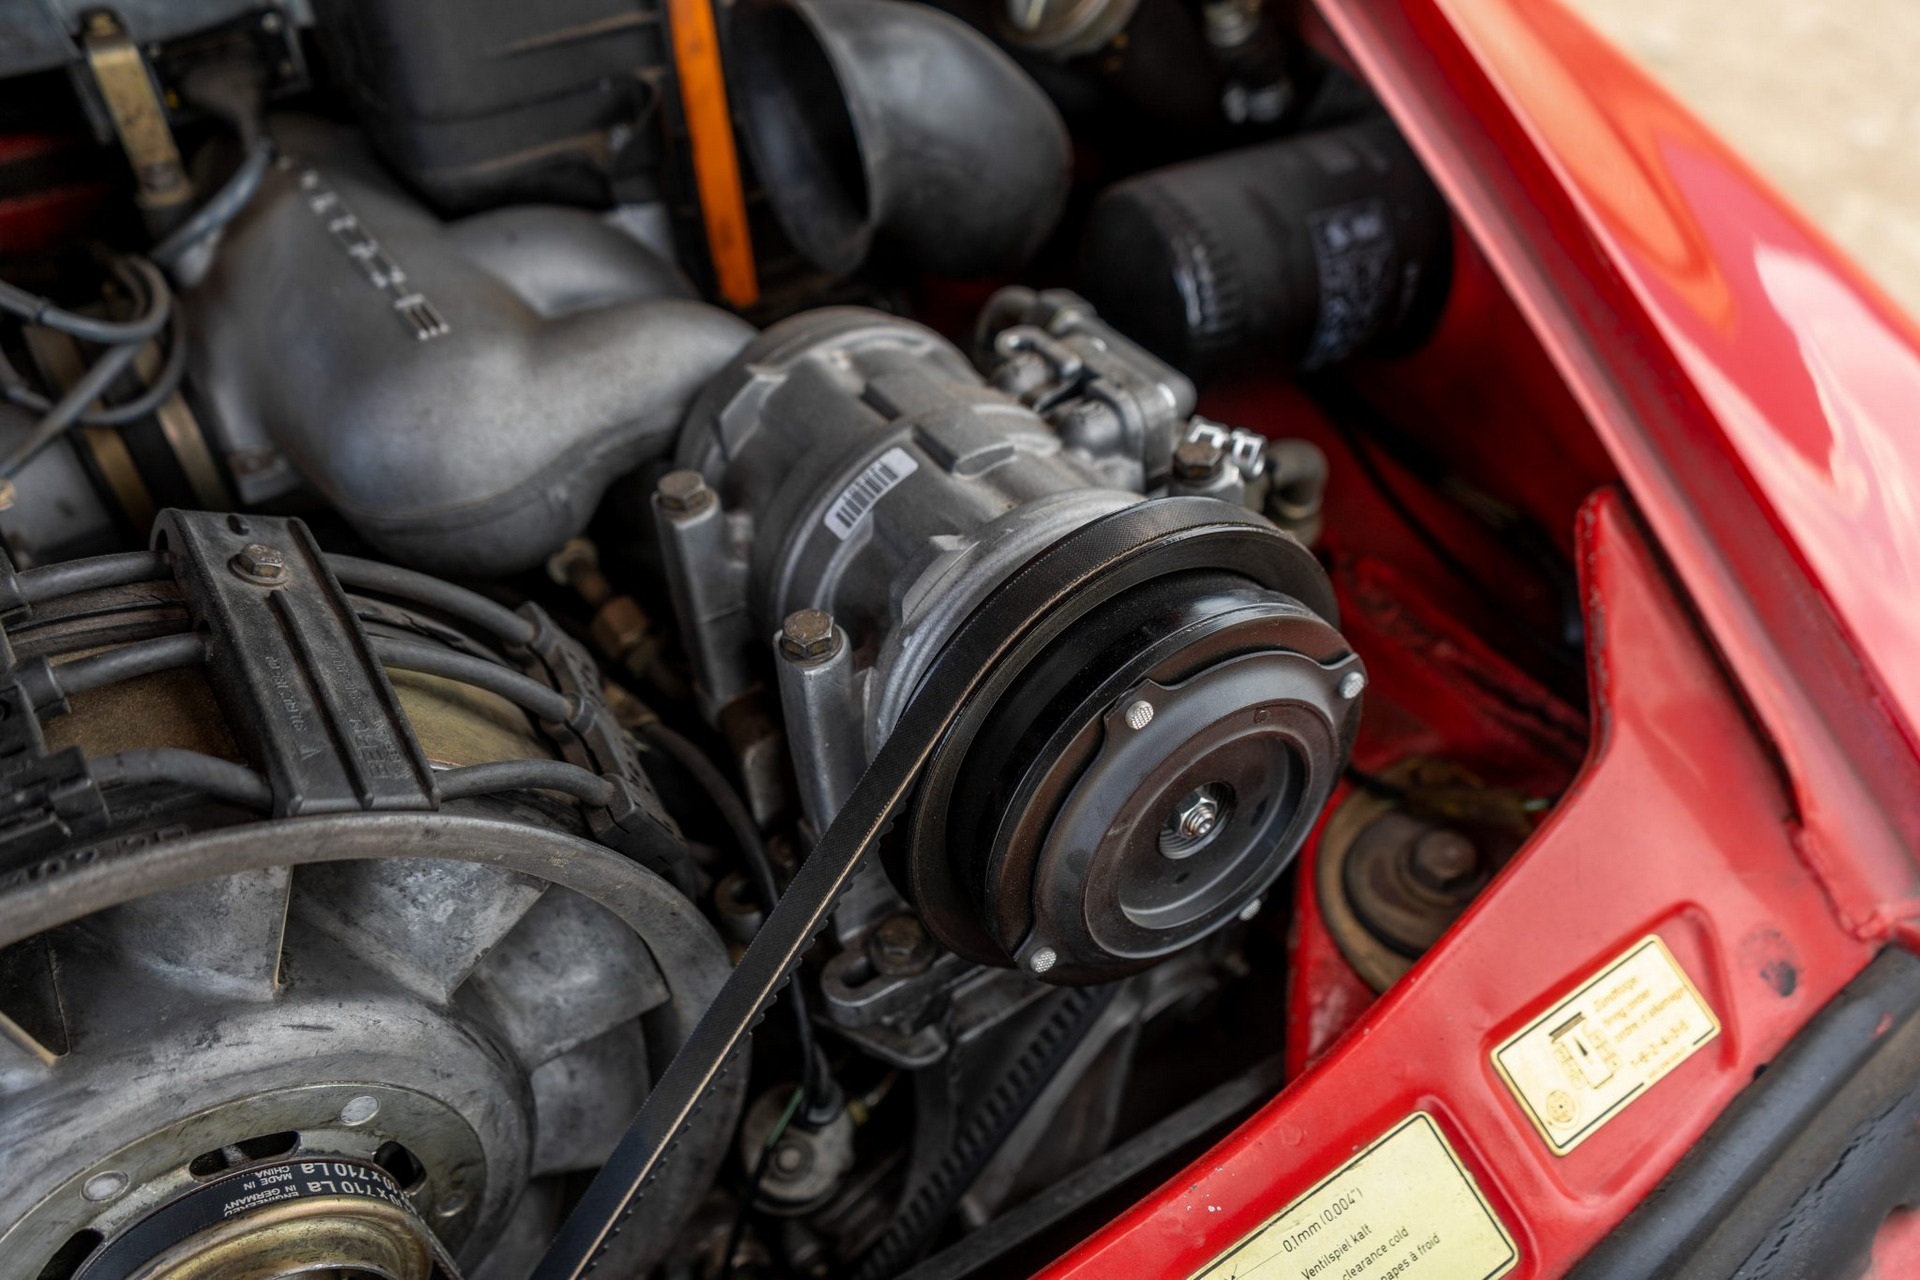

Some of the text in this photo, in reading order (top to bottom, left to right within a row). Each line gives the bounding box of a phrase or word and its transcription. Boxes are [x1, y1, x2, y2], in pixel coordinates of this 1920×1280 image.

[254, 1165, 290, 1179] CHINA
[301, 1162, 329, 1176] La
[243, 1171, 292, 1191] MADE IN
[307, 1180, 337, 1193] La
[223, 1184, 297, 1211] IN GERMANY
[1301, 1224, 1373, 1280] Ventilspiel kalt
[1342, 1226, 1410, 1280] clearance cold
[1409, 1251, 1419, 1262] à
[1416, 1232, 1441, 1256] froid
